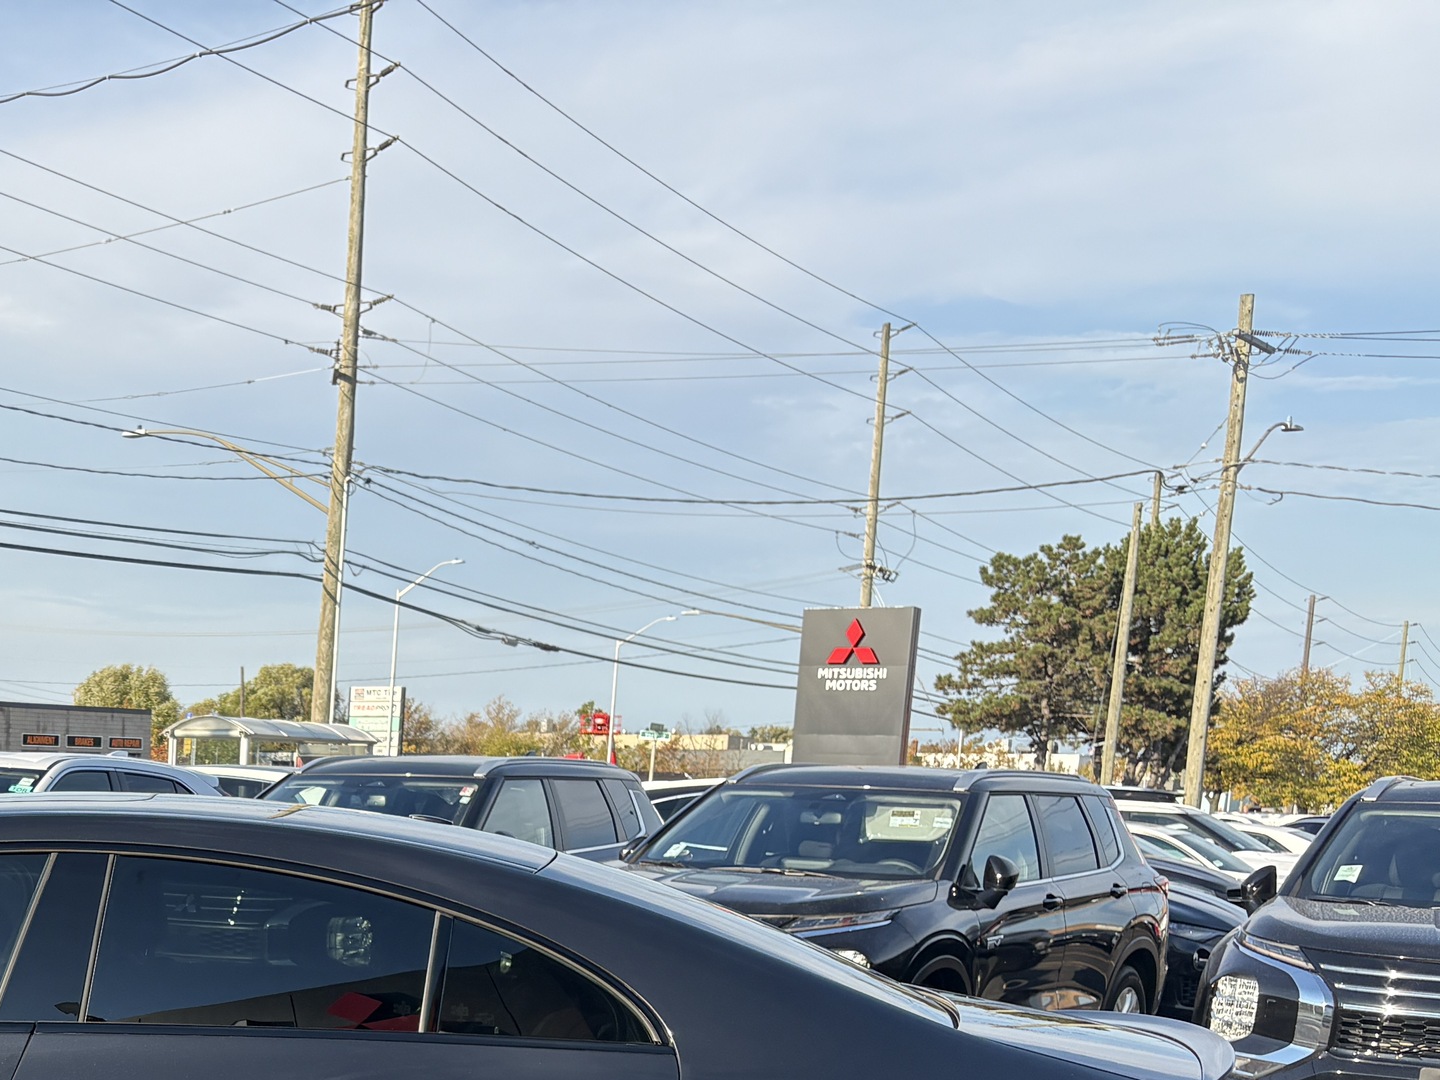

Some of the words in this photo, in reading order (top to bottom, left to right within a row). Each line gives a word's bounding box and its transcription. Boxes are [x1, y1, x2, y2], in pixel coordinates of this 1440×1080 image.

[817, 667, 888, 679] MITSUBISHI
[825, 679, 878, 691] MOTORS
[26, 735, 56, 745] ALIGNMENT
[74, 737, 95, 746] BRAKES
[124, 739, 142, 748] REPAIR
